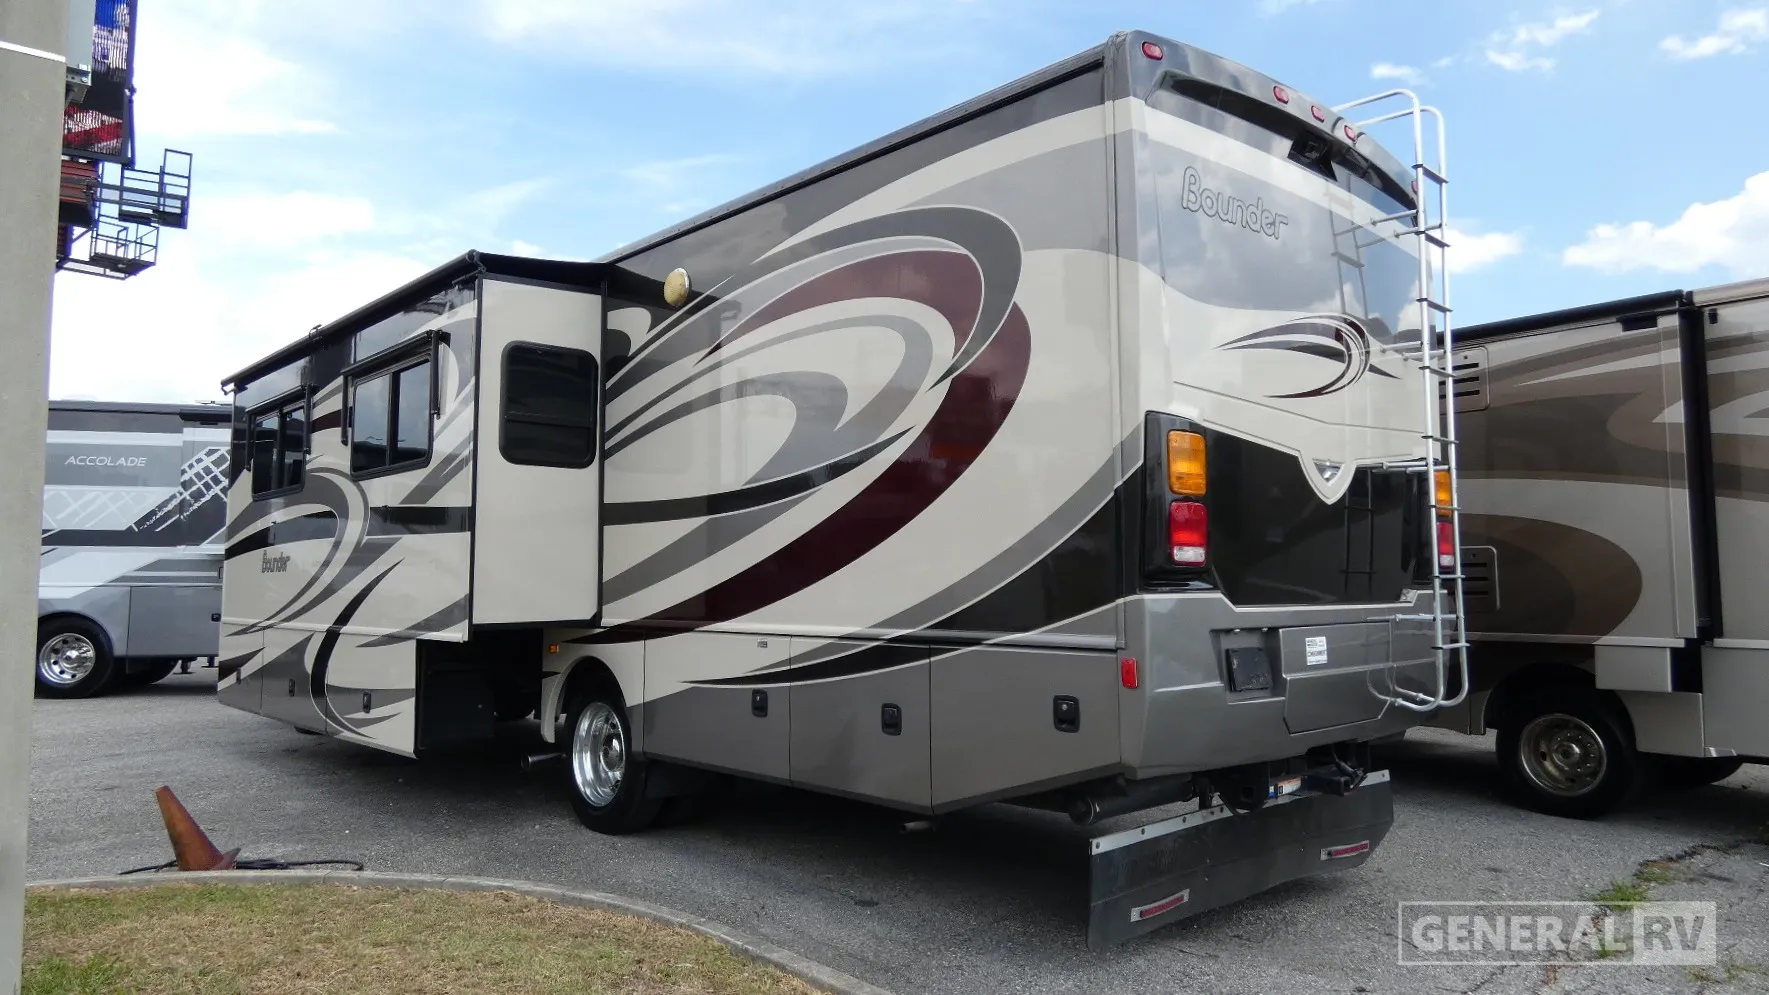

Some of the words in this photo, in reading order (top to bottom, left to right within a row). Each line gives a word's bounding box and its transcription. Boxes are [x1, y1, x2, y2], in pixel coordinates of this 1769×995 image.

[1182, 166, 1288, 240] Bounder
[64, 455, 148, 467] ACCOLADE
[261, 550, 291, 573] Bounder
